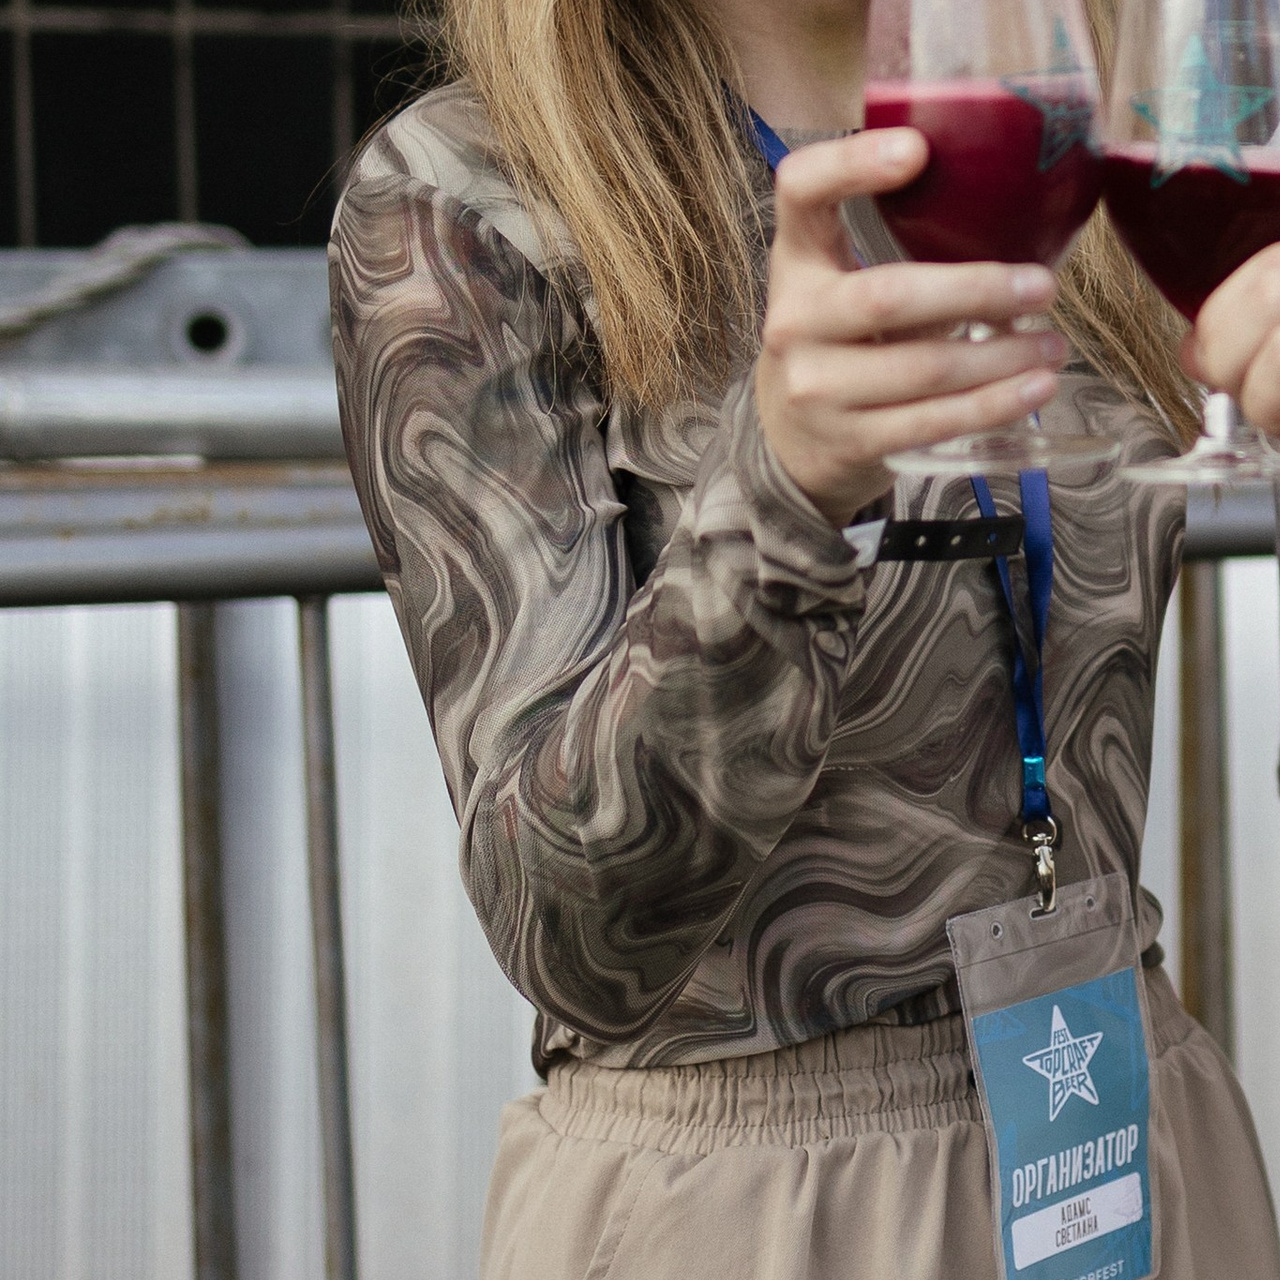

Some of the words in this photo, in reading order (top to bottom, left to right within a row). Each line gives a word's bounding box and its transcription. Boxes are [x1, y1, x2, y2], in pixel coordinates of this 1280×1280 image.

[1024, 1034, 1100, 1078] TOPCRAFT
[1053, 1027, 1070, 1047] FEST
[1052, 1071, 1098, 1118] BEER
[1012, 1124, 1138, 1208] ОРГАНИЗАТОР
[1061, 1197, 1092, 1225] АДАМС
[1055, 1215, 1099, 1248] СВЕТЛАНА
